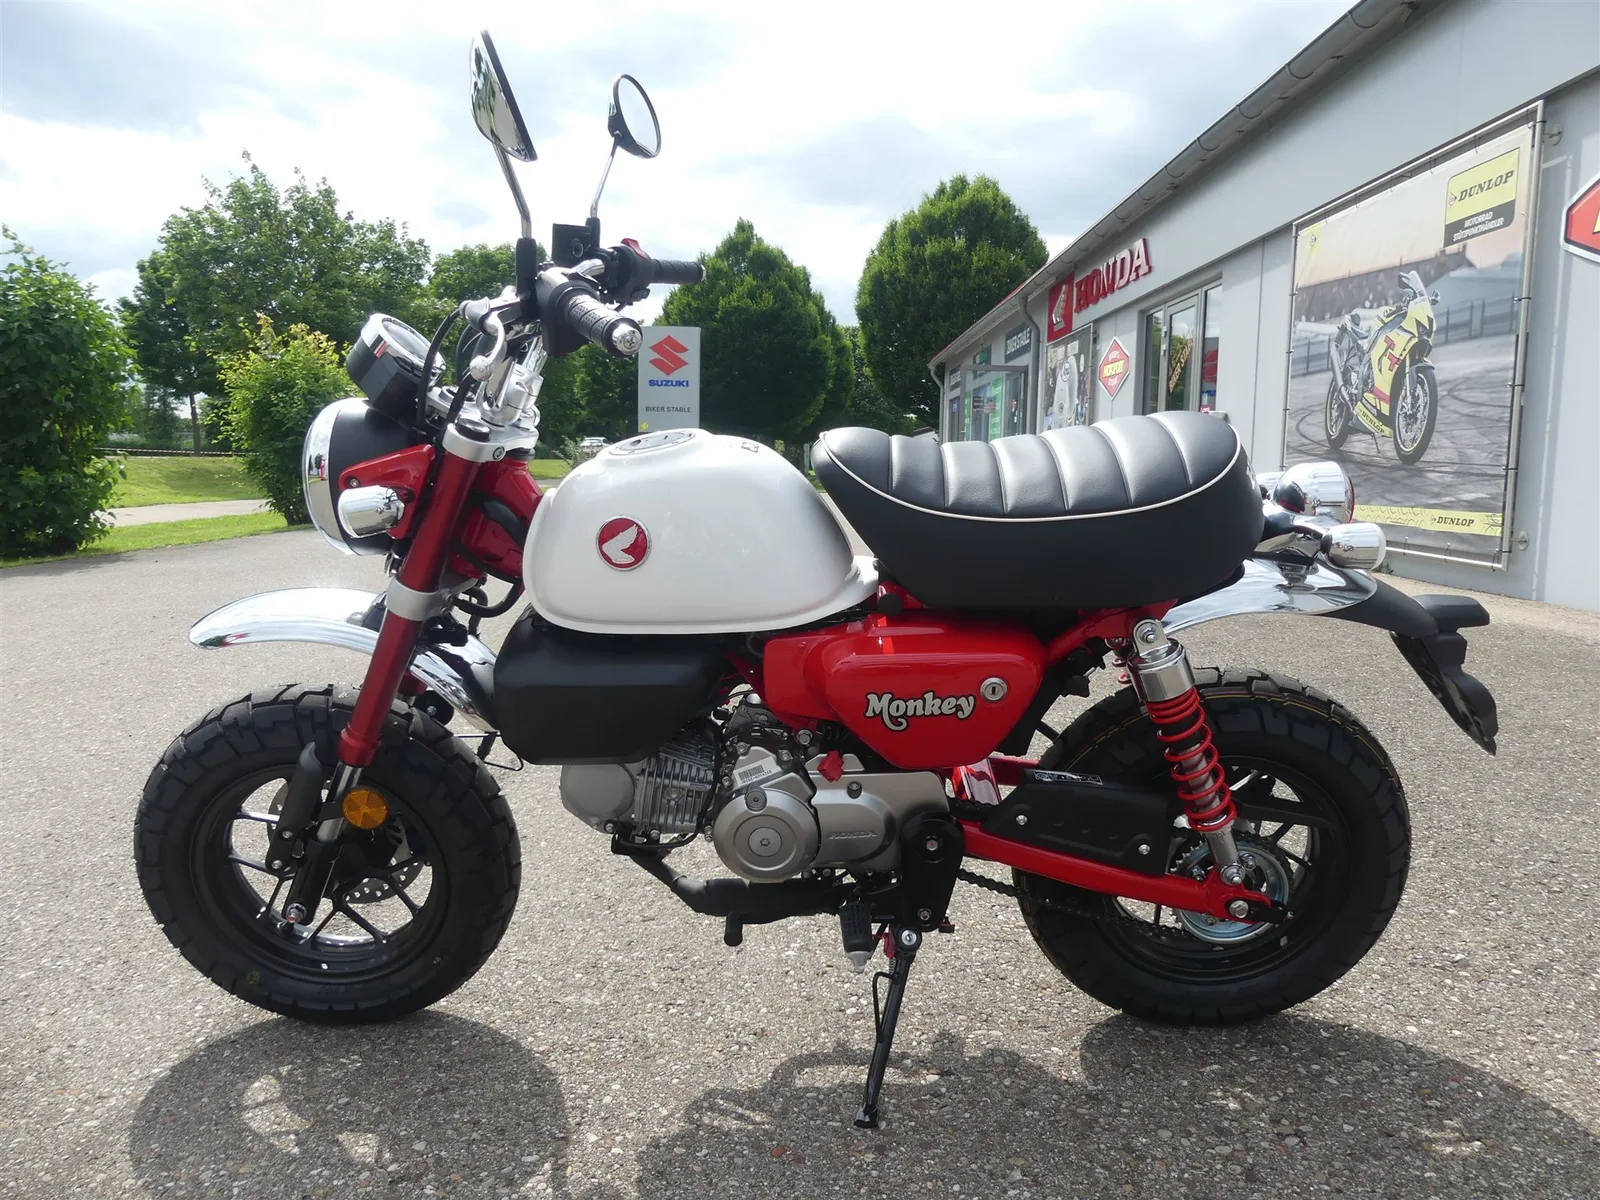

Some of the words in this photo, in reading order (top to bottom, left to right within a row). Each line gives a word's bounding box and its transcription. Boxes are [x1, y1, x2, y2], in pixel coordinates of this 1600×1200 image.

[1458, 170, 1514, 202] DUNLOP
[1464, 211, 1493, 228] MOTORRAD
[1073, 237, 1152, 314] HONDA
[648, 379, 690, 388] SUZUKI
[1361, 411, 1386, 435] DUNLOP
[1436, 516, 1475, 527] DUNLOP
[865, 690, 976, 732] Monkey
[828, 831, 878, 840] HONDA
